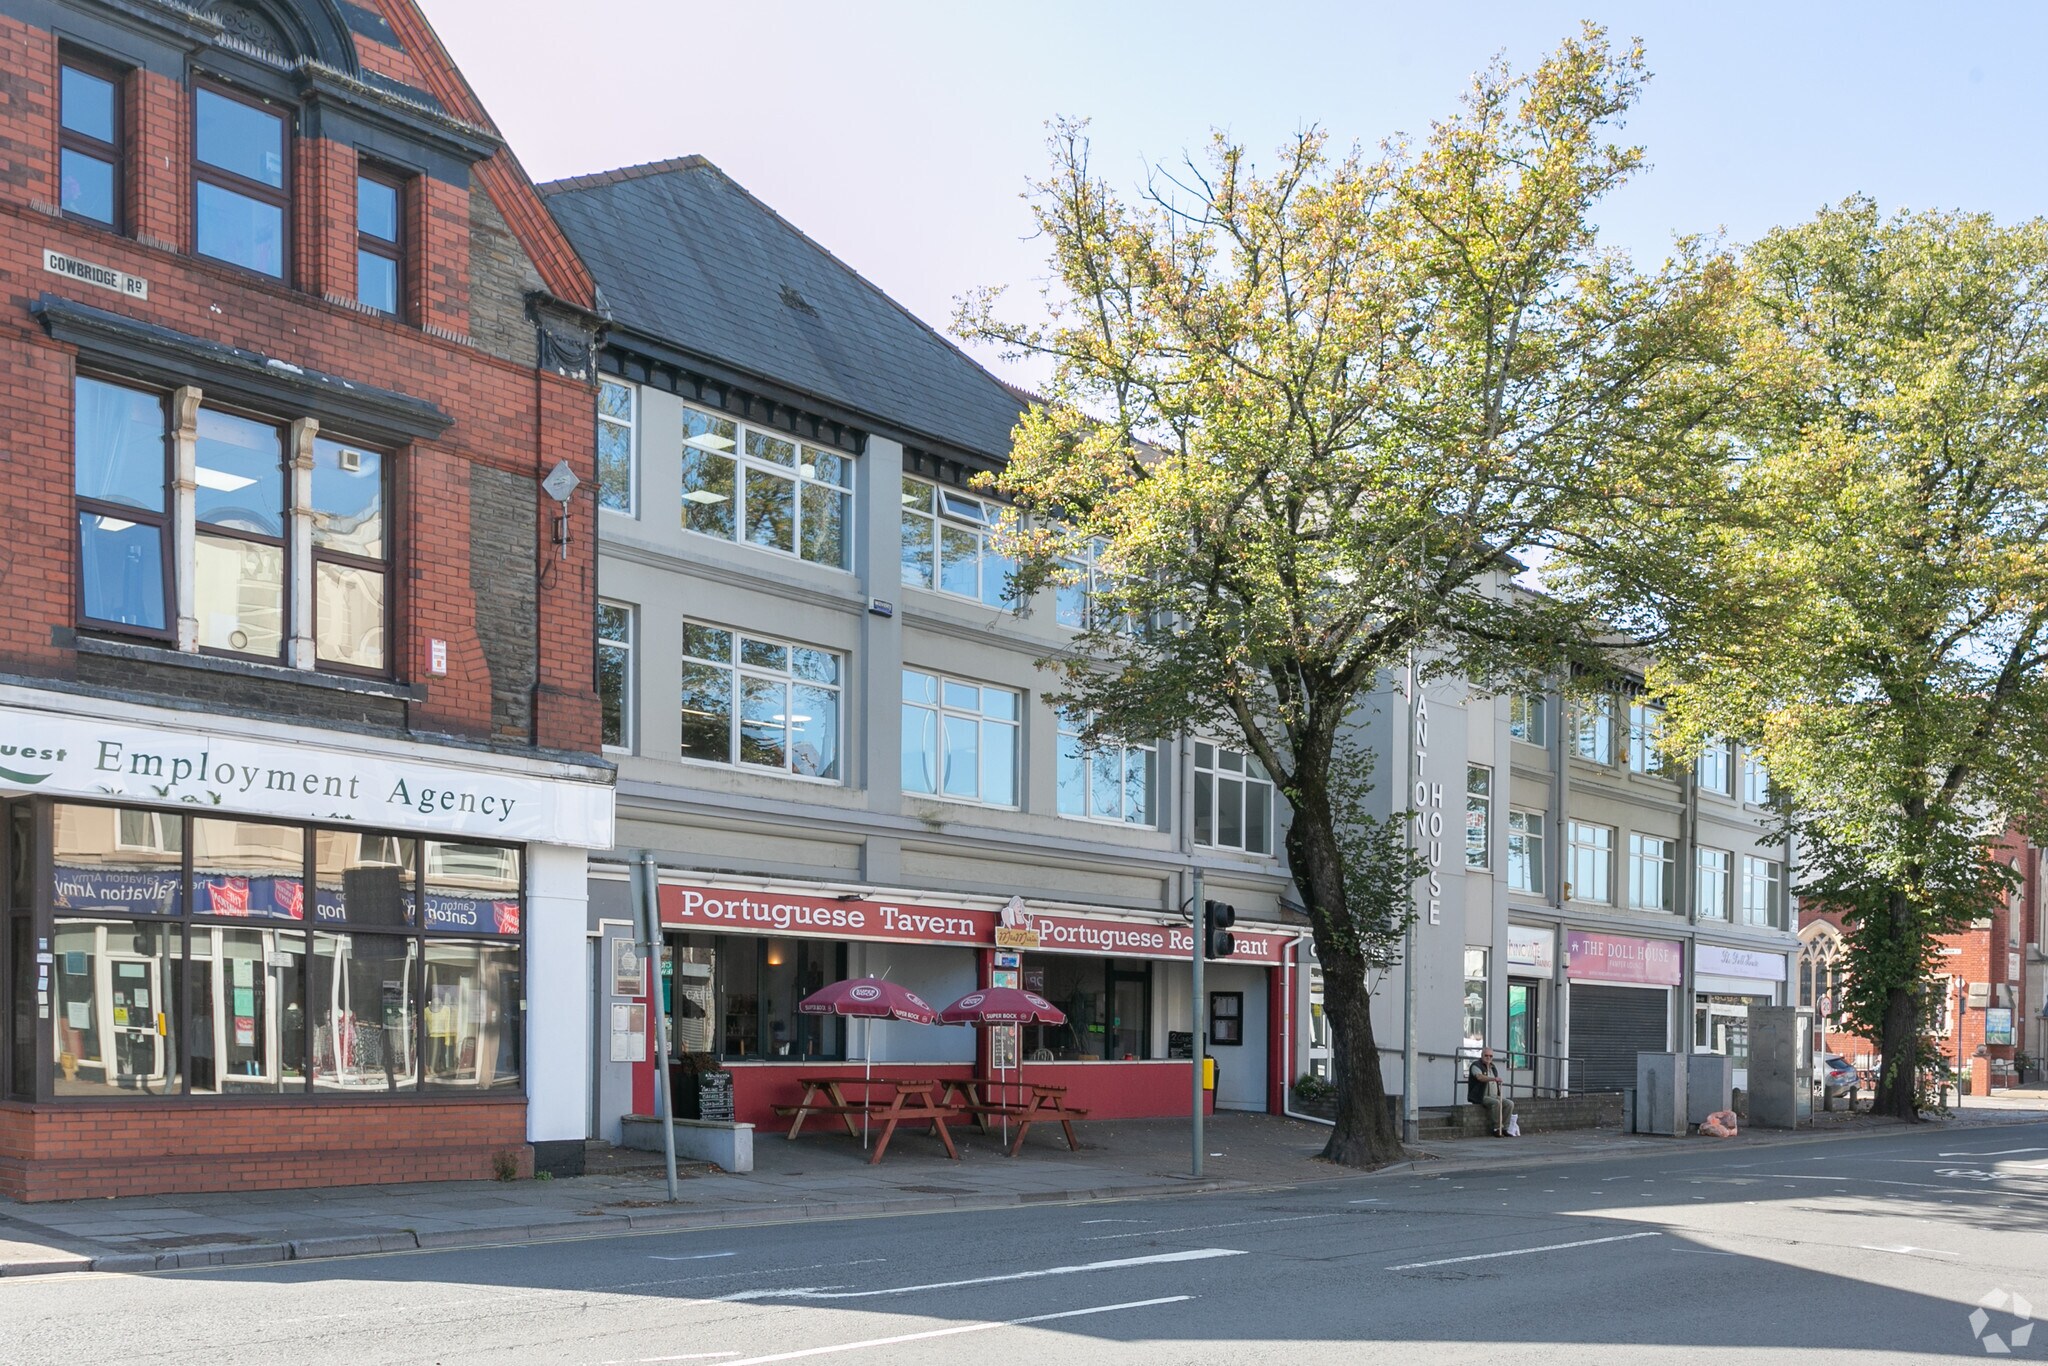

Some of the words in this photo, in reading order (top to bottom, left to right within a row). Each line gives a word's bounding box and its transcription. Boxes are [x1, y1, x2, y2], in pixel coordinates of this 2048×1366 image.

[50, 254, 118, 288] COWBRIDGE
[94, 740, 360, 800] Employment
[386, 777, 516, 822] Agency
[1429, 782, 1443, 926] HOUSE
[681, 890, 865, 929] Portuguese
[880, 906, 976, 936] Tavern
[1039, 919, 1163, 950] Portuguese
[1169, 930, 1268, 956] Rerant
[1583, 940, 1604, 957] THE
[1608, 943, 1634, 960] DOLL
[1637, 945, 1669, 962] HOUSE
